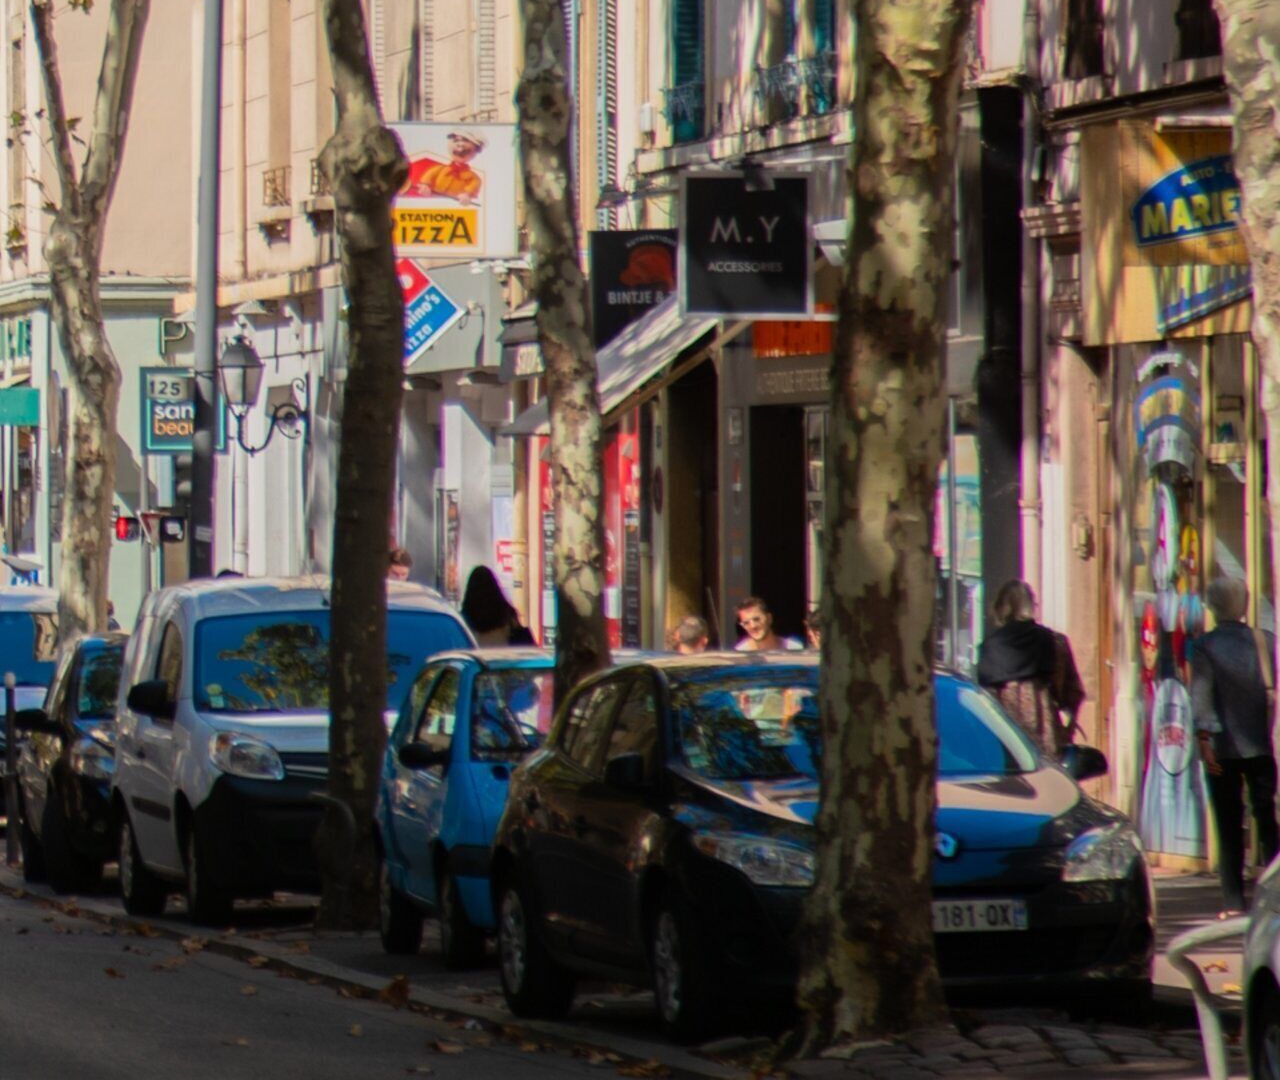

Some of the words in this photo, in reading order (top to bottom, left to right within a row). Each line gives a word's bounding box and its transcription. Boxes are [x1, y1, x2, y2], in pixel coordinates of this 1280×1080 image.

[399, 213, 454, 222] STATION
[394, 217, 473, 245] IZZA
[710, 216, 780, 244] M.Y
[707, 262, 783, 273] ACCESSORIES
[607, 291, 652, 305] BINTJE
[149, 380, 181, 396] 125
